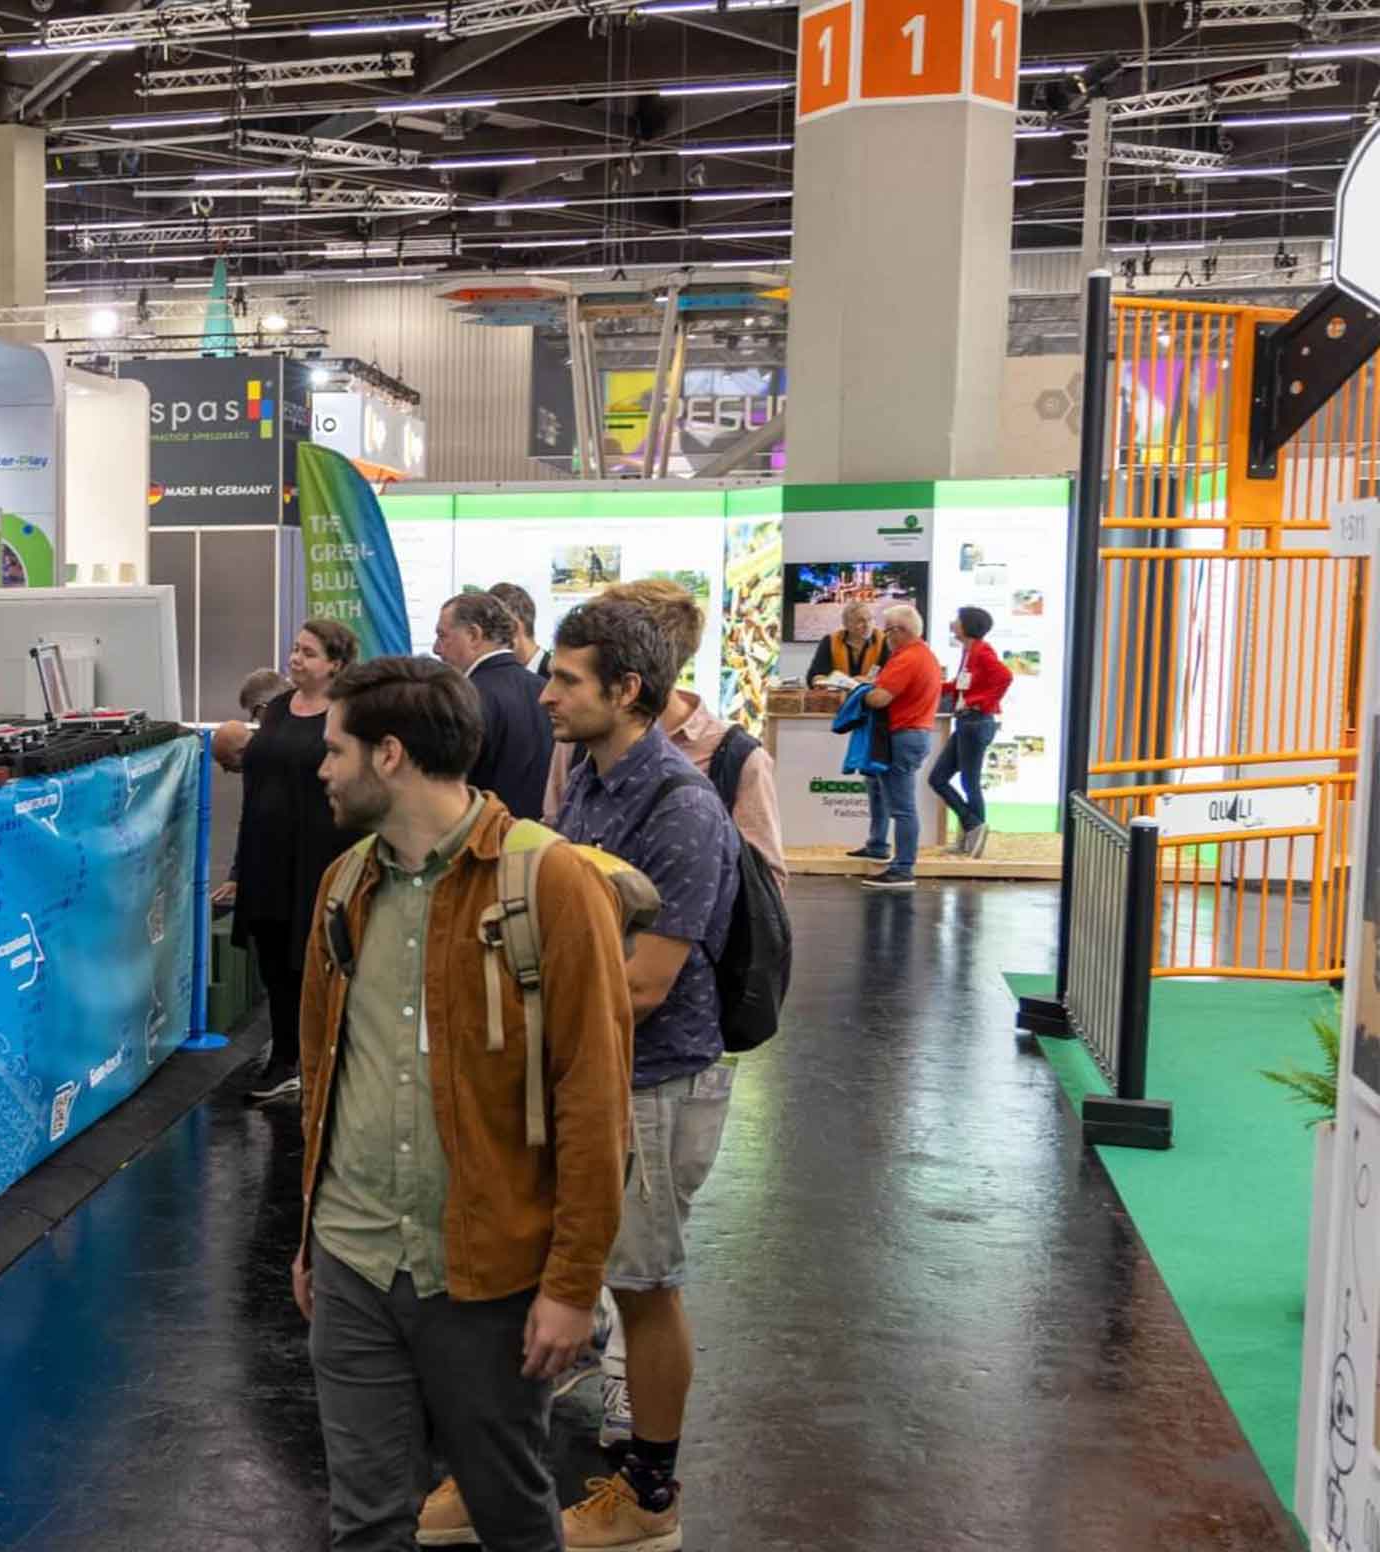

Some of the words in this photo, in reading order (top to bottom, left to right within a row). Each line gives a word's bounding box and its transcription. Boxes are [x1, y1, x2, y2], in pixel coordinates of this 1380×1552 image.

[817, 25, 832, 86] 1
[899, 14, 927, 76] 1
[990, 20, 1004, 79] 1
[164, 486, 197, 496] MADE
[200, 486, 213, 495] IN
